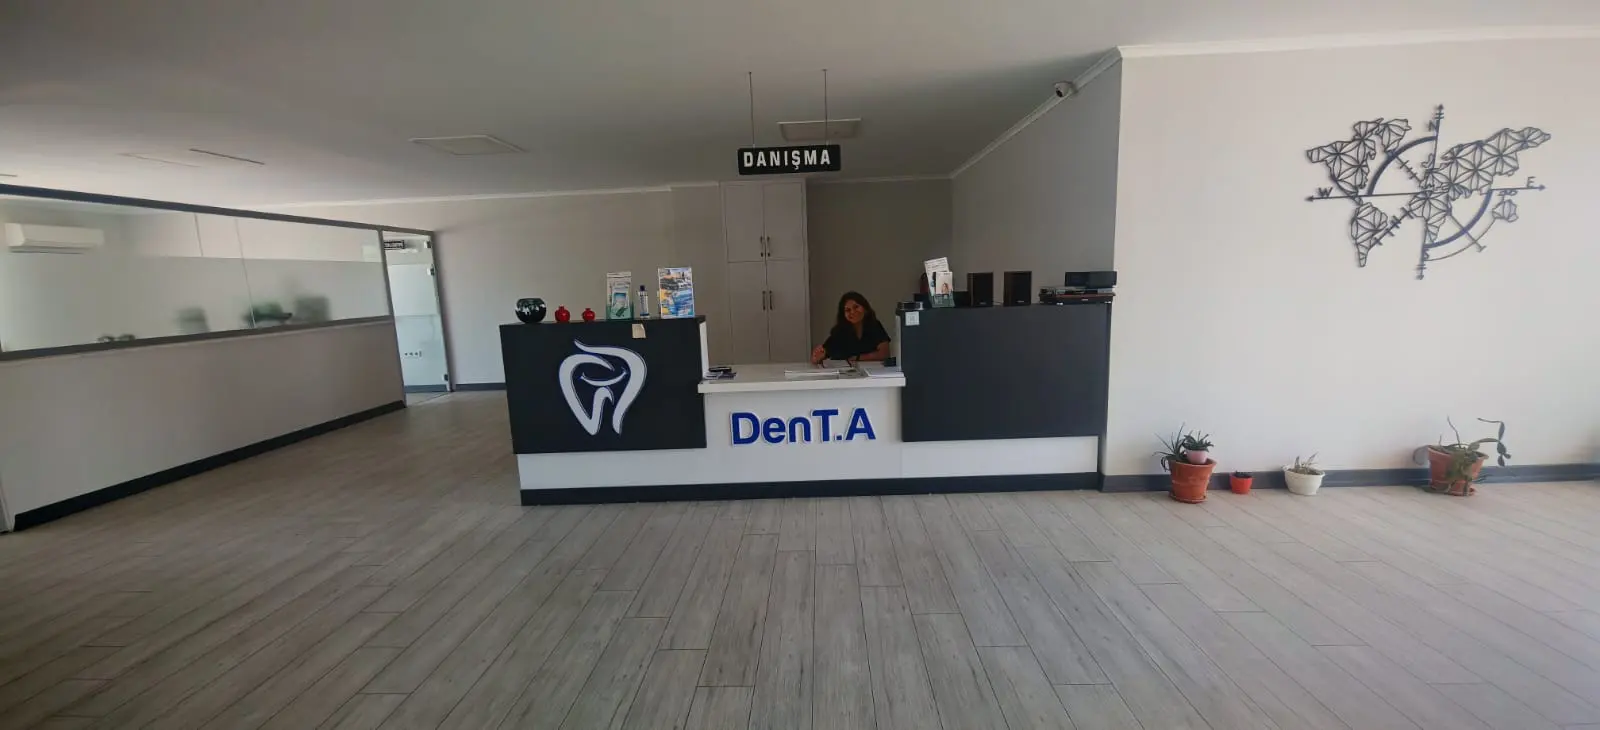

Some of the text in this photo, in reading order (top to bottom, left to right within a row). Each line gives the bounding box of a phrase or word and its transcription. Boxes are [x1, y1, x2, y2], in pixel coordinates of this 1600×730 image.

[1428, 122, 1438, 132] N
[743, 149, 831, 170] DANIŞMA
[1526, 176, 1536, 188] E
[1318, 187, 1333, 198] W
[731, 407, 876, 446] DenT.A
